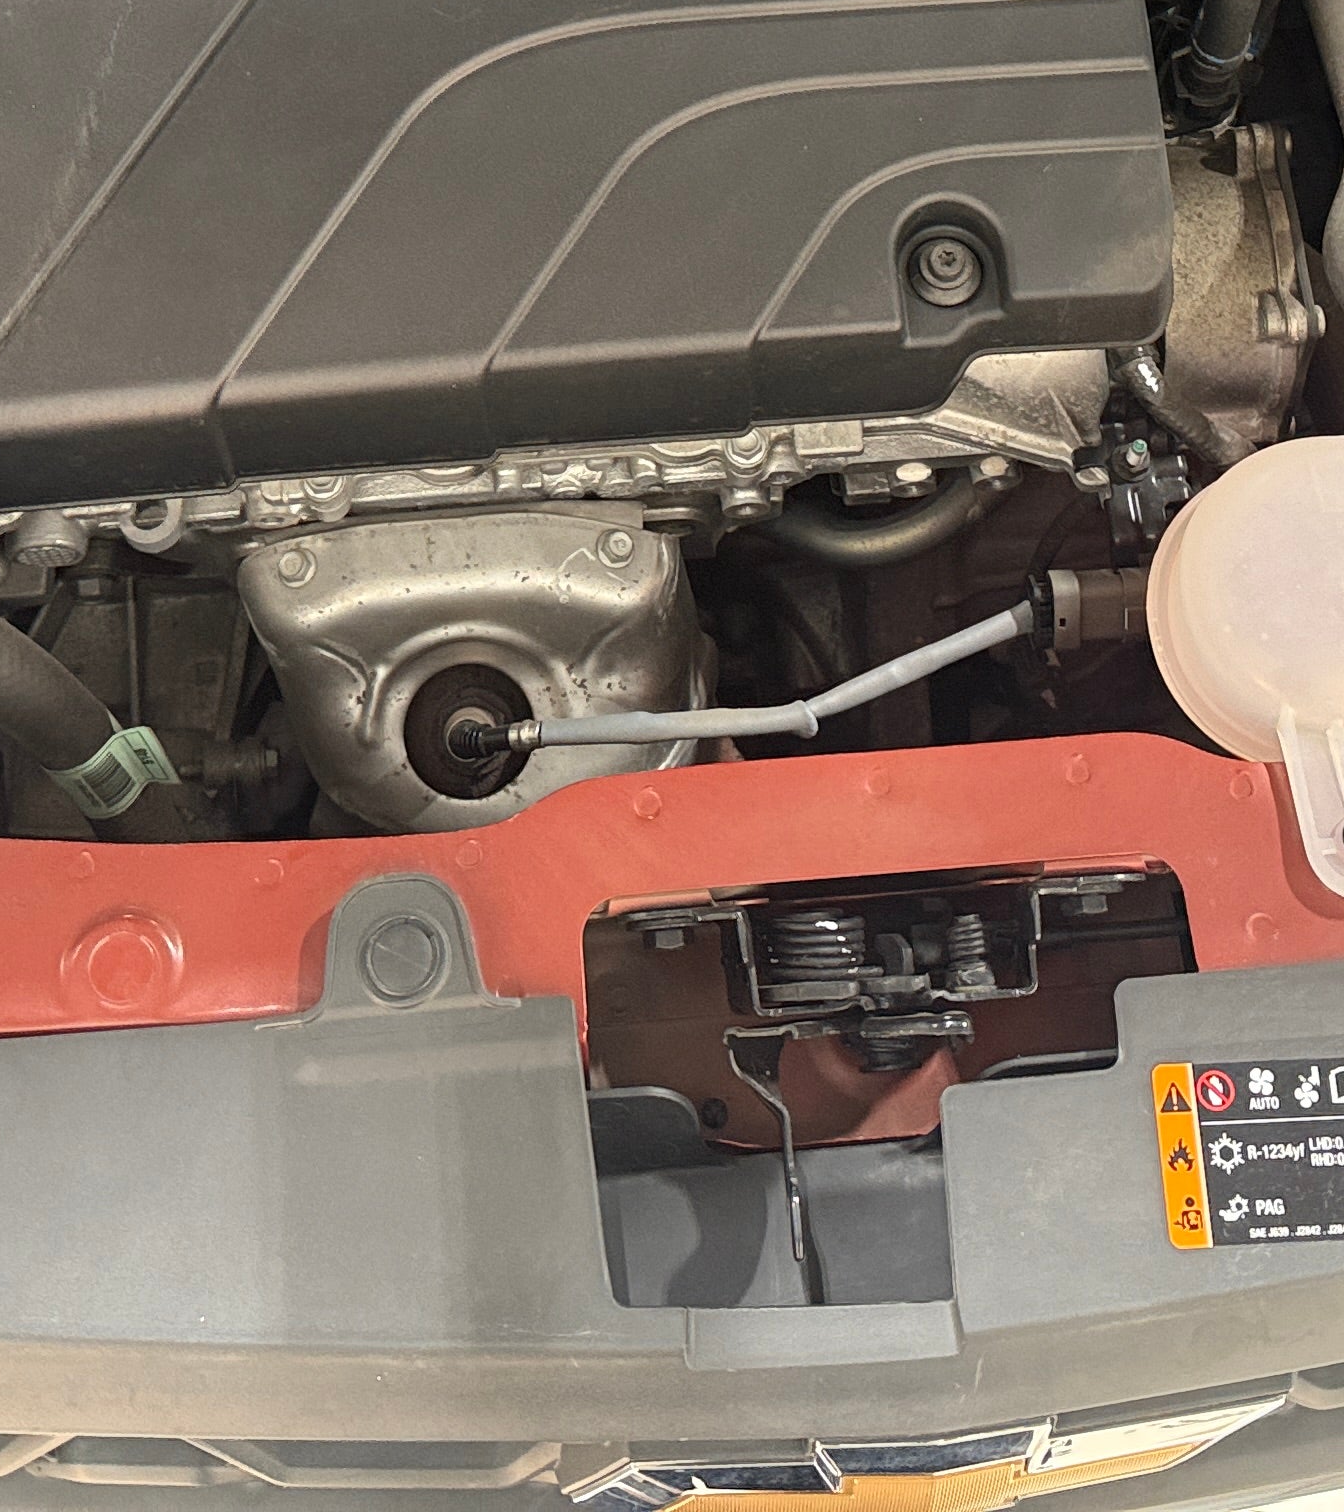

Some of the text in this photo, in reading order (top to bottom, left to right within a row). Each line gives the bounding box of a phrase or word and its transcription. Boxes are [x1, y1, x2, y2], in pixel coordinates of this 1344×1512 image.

[1248, 1097, 1280, 1111] AUTO
[1247, 1142, 1305, 1162] R-1234yf
[1255, 1198, 1286, 1216] PAG
[1249, 1227, 1268, 1238] SAE
